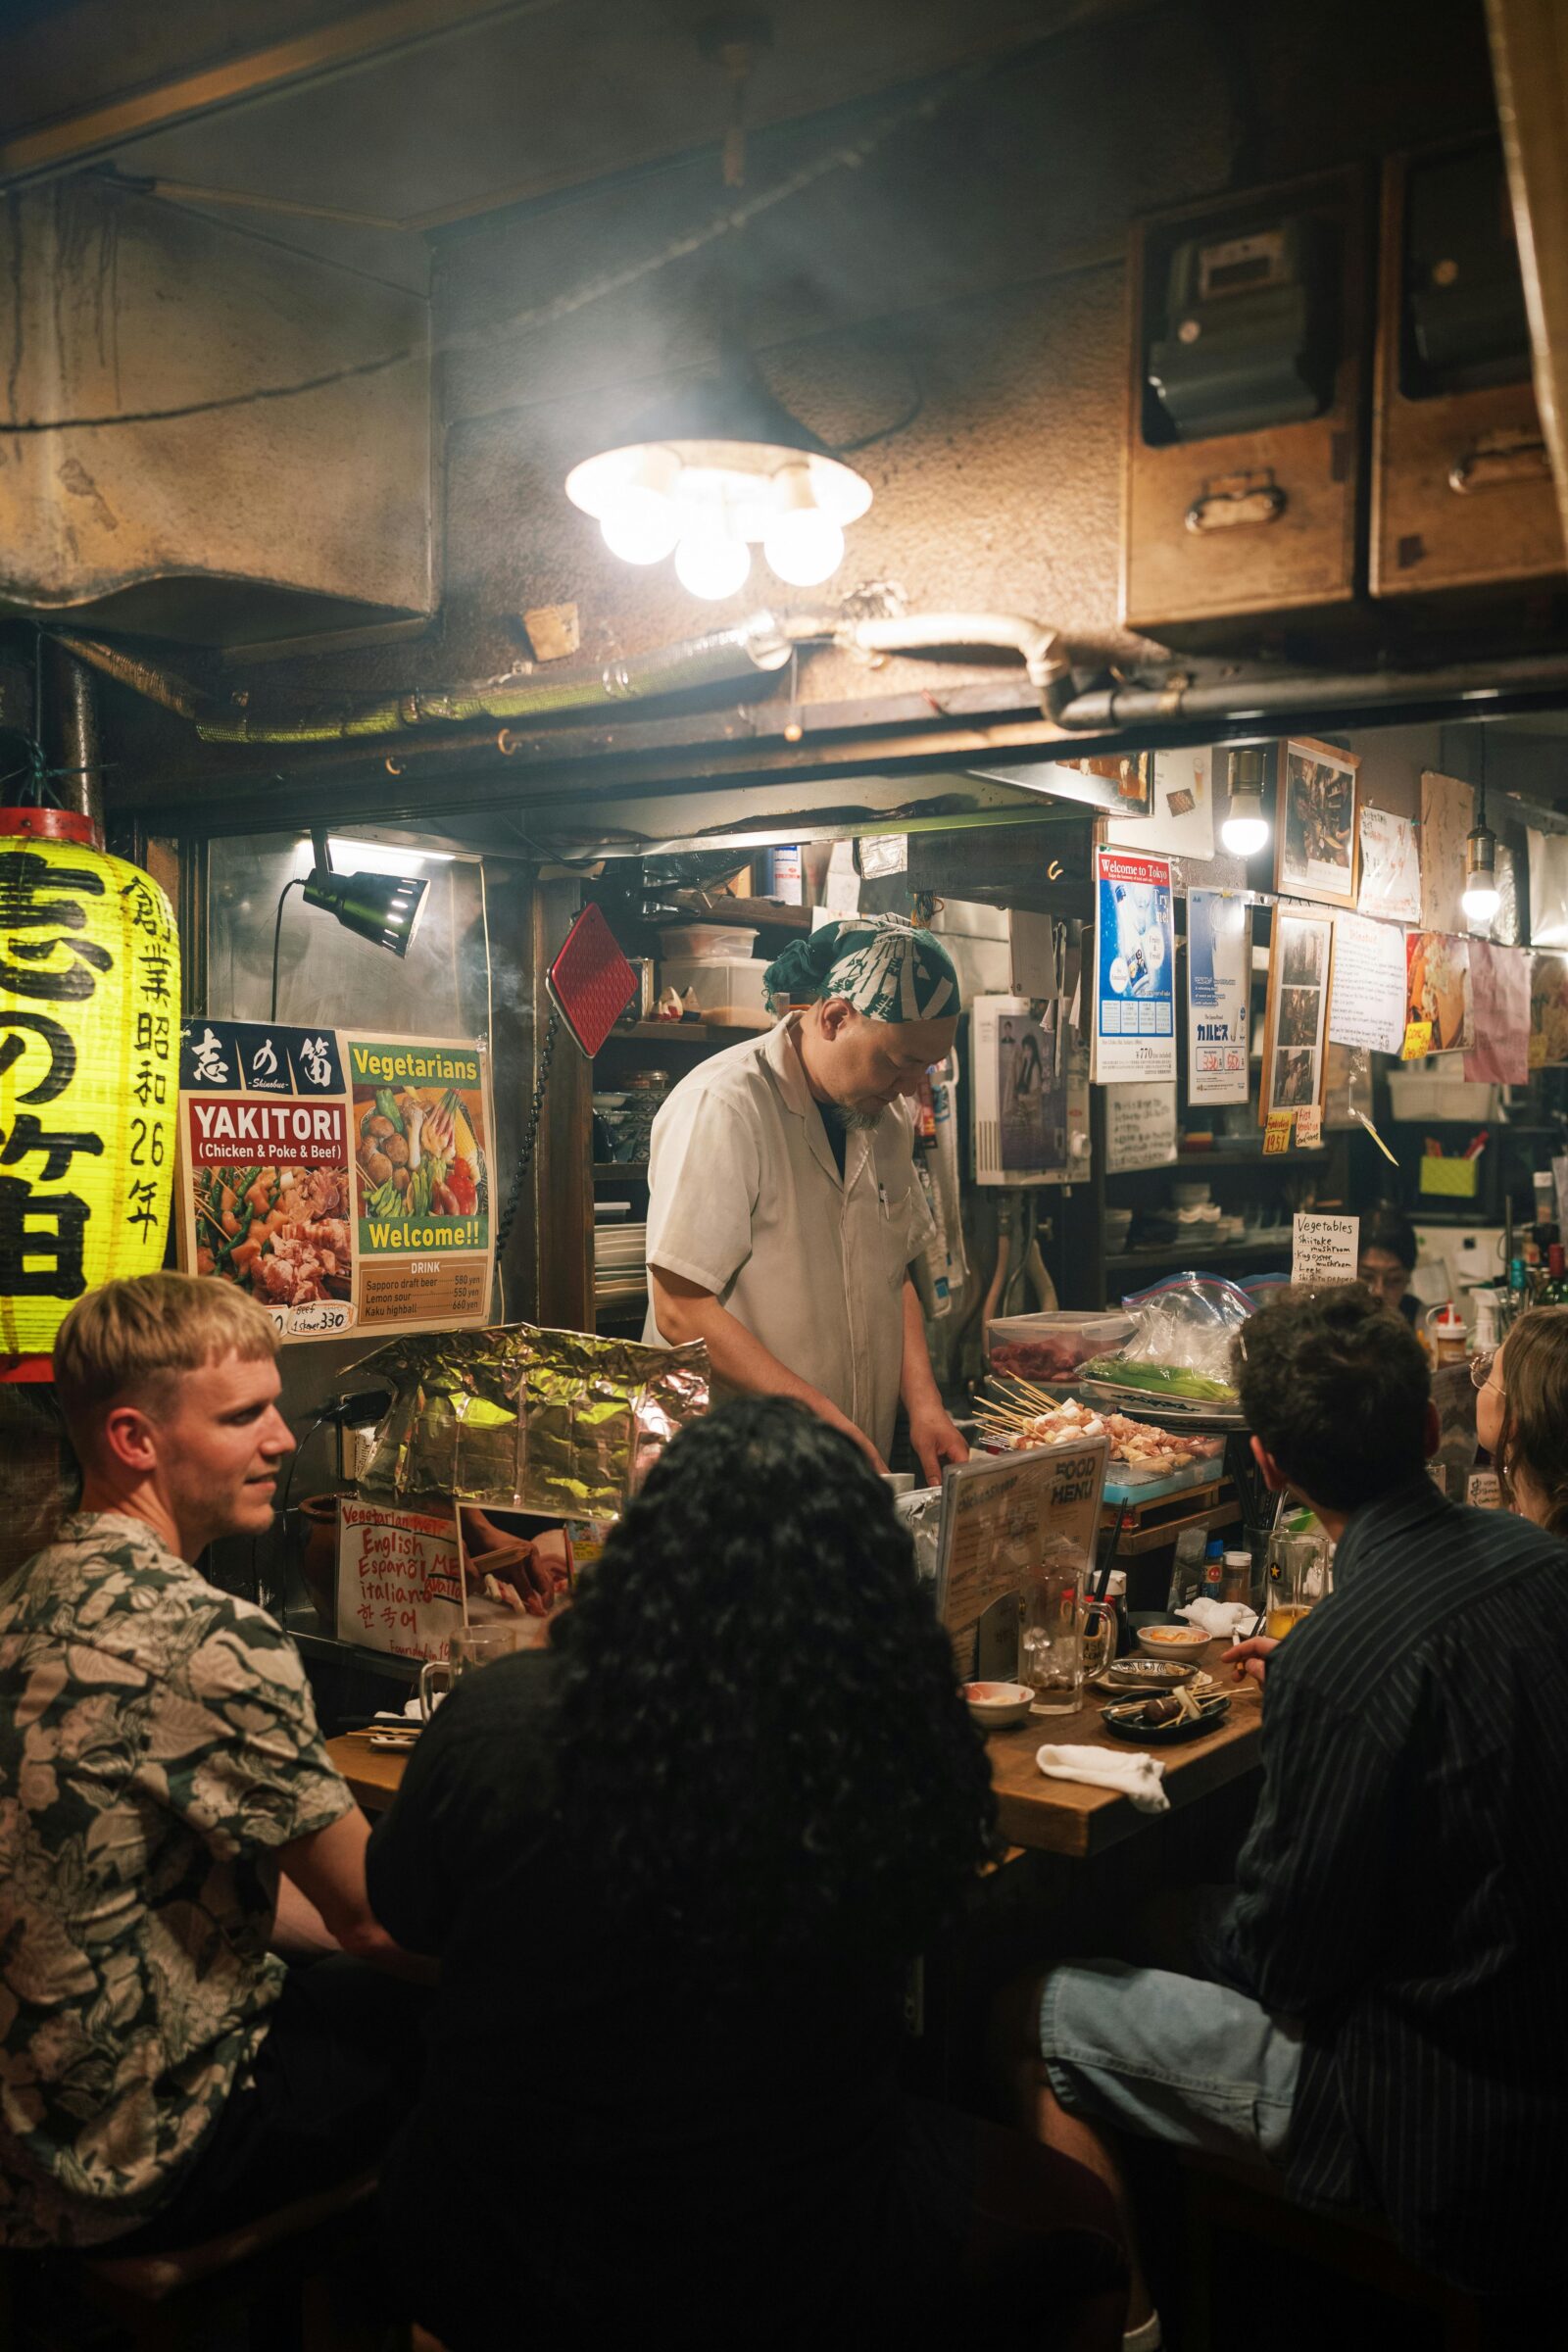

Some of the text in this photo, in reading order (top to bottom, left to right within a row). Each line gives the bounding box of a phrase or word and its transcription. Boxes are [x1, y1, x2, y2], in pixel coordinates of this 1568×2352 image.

[1102, 858, 1168, 883] Welcome to Tokyo
[1197, 1023, 1229, 1042] カルピス
[191, 1027, 332, 1088] 志の笛
[353, 1048, 478, 1081] Vegetarians
[194, 1105, 341, 1141] YAKITORI
[257, 1146, 266, 1157] &
[269, 1145, 297, 1158] Poke
[300, 1146, 308, 1157] &
[1298, 1216, 1353, 1234] Vegetables
[368, 1221, 479, 1249] Welcome!!
[1298, 1235, 1332, 1246] Shiitake
[411, 1261, 441, 1274] DRINK
[1298, 1262, 1322, 1274] Leek
[367, 1279, 399, 1293] Sapporo
[400, 1278, 419, 1290] draft
[420, 1278, 438, 1287] beer
[468, 1277, 480, 1286] yen
[366, 1287, 479, 1304] Lemon sour 550 yen
[365, 1299, 478, 1318] Kaku highball 660 yen
[320, 1311, 345, 1330] 330
[1055, 1456, 1096, 1481] FOOD
[1051, 1480, 1095, 1506] MENU
[341, 1506, 409, 1528] Vegetarian
[362, 1527, 423, 1557] English
